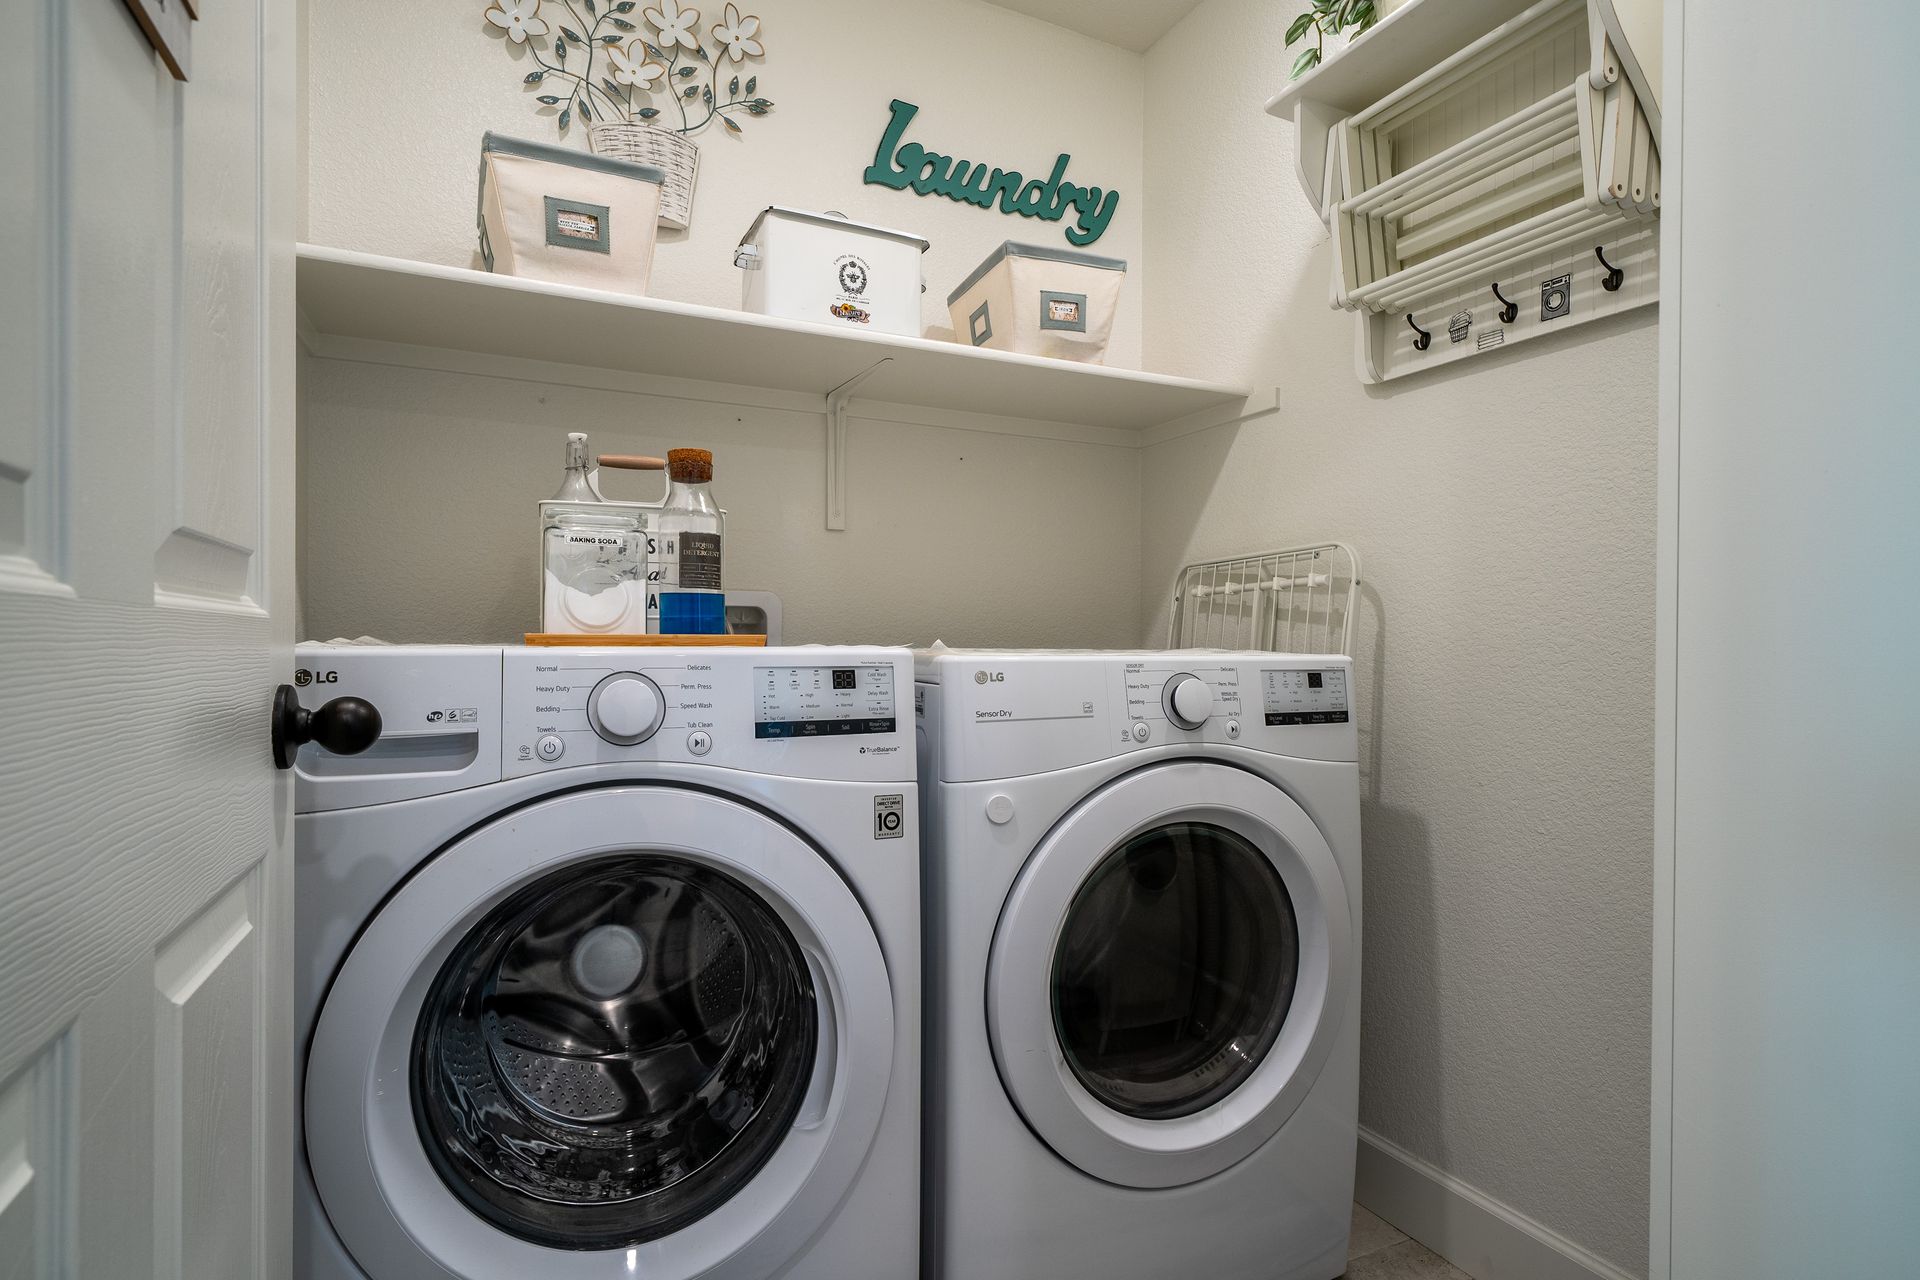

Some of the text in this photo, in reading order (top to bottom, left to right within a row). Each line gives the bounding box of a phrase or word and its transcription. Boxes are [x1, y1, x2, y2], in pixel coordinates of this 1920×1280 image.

[864, 99, 1119, 246] Laundry
[570, 536, 595, 544] BAKING
[683, 549, 720, 558] DETERGENT
[316, 670, 338, 684] LG
[989, 672, 1004, 682] LG
[536, 706, 560, 714] Bedding
[877, 812, 900, 832] 10
